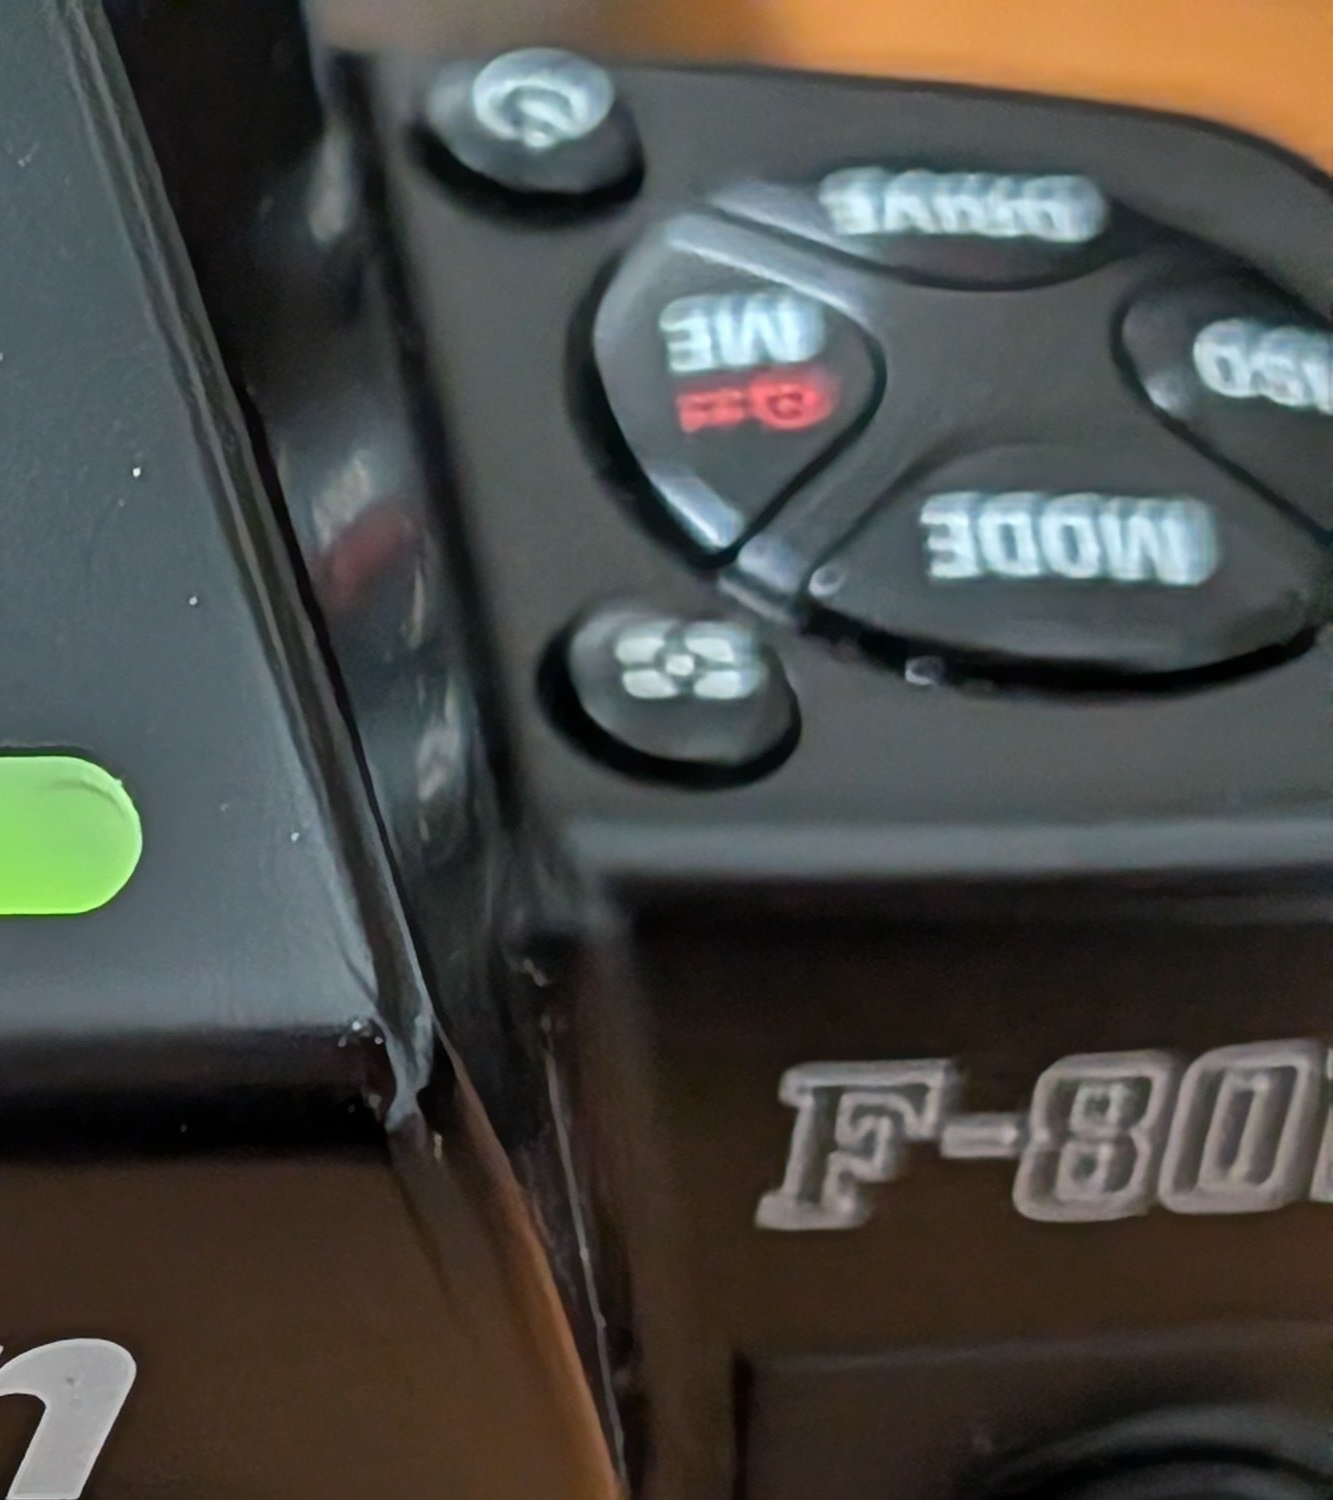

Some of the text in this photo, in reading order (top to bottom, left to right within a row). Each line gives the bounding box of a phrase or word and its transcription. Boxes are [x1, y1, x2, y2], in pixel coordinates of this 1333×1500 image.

[659, 293, 827, 374] ME
[921, 493, 1218, 585] MODE
[755, 1038, 1333, 1230] F-80
